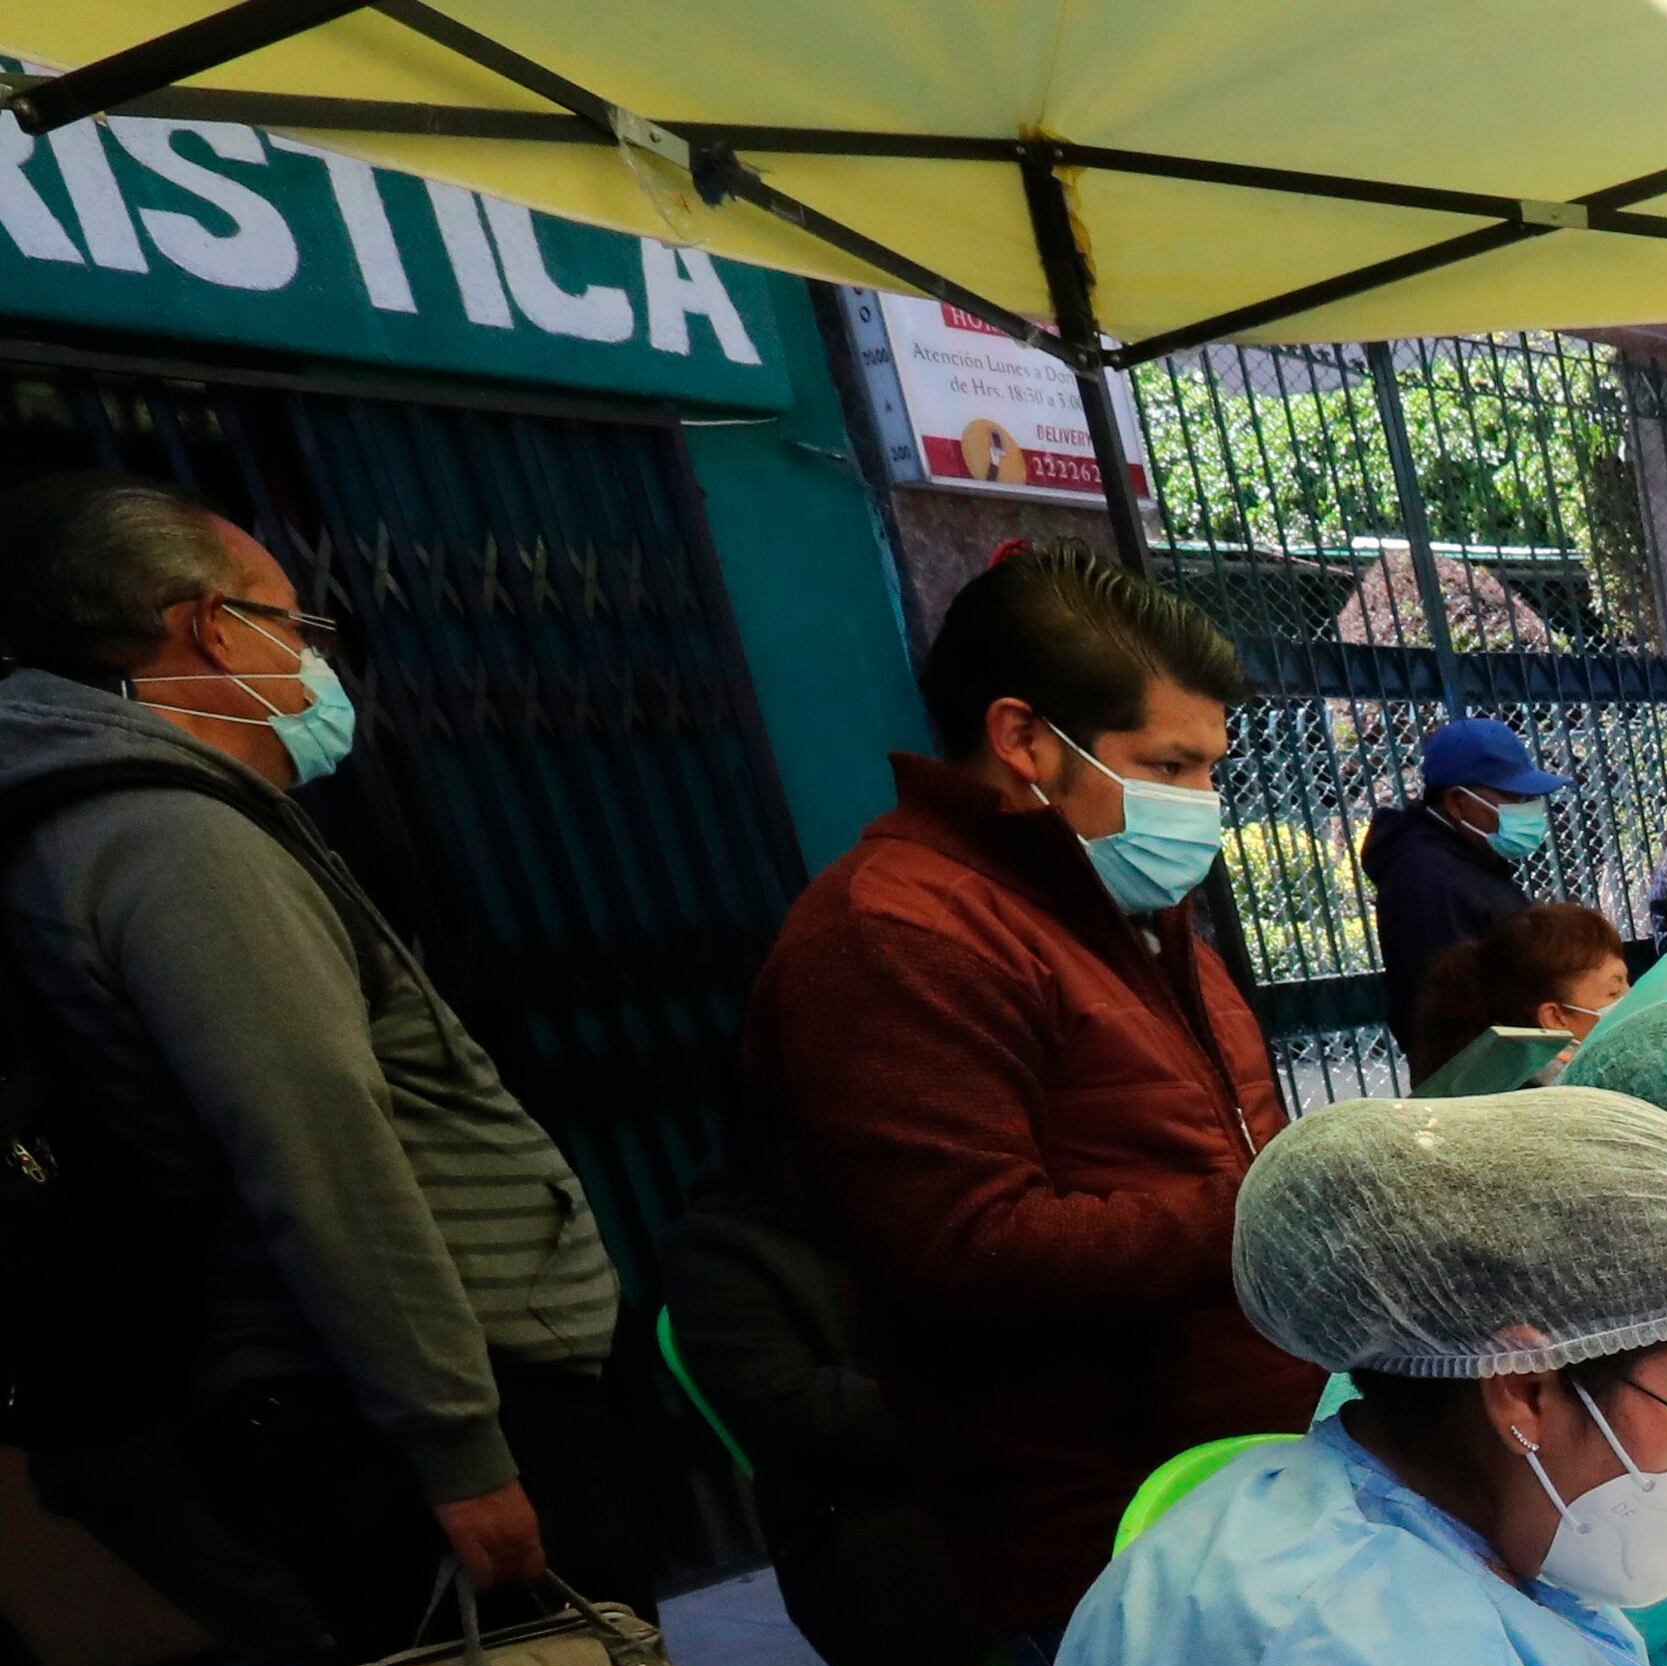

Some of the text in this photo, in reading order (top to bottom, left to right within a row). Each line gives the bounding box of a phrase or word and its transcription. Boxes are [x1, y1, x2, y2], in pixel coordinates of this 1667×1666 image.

[912, 342, 983, 371] Atención
[987, 355, 1030, 378] Lunes
[950, 375, 968, 393] de
[1032, 456, 1102, 483] 222262
